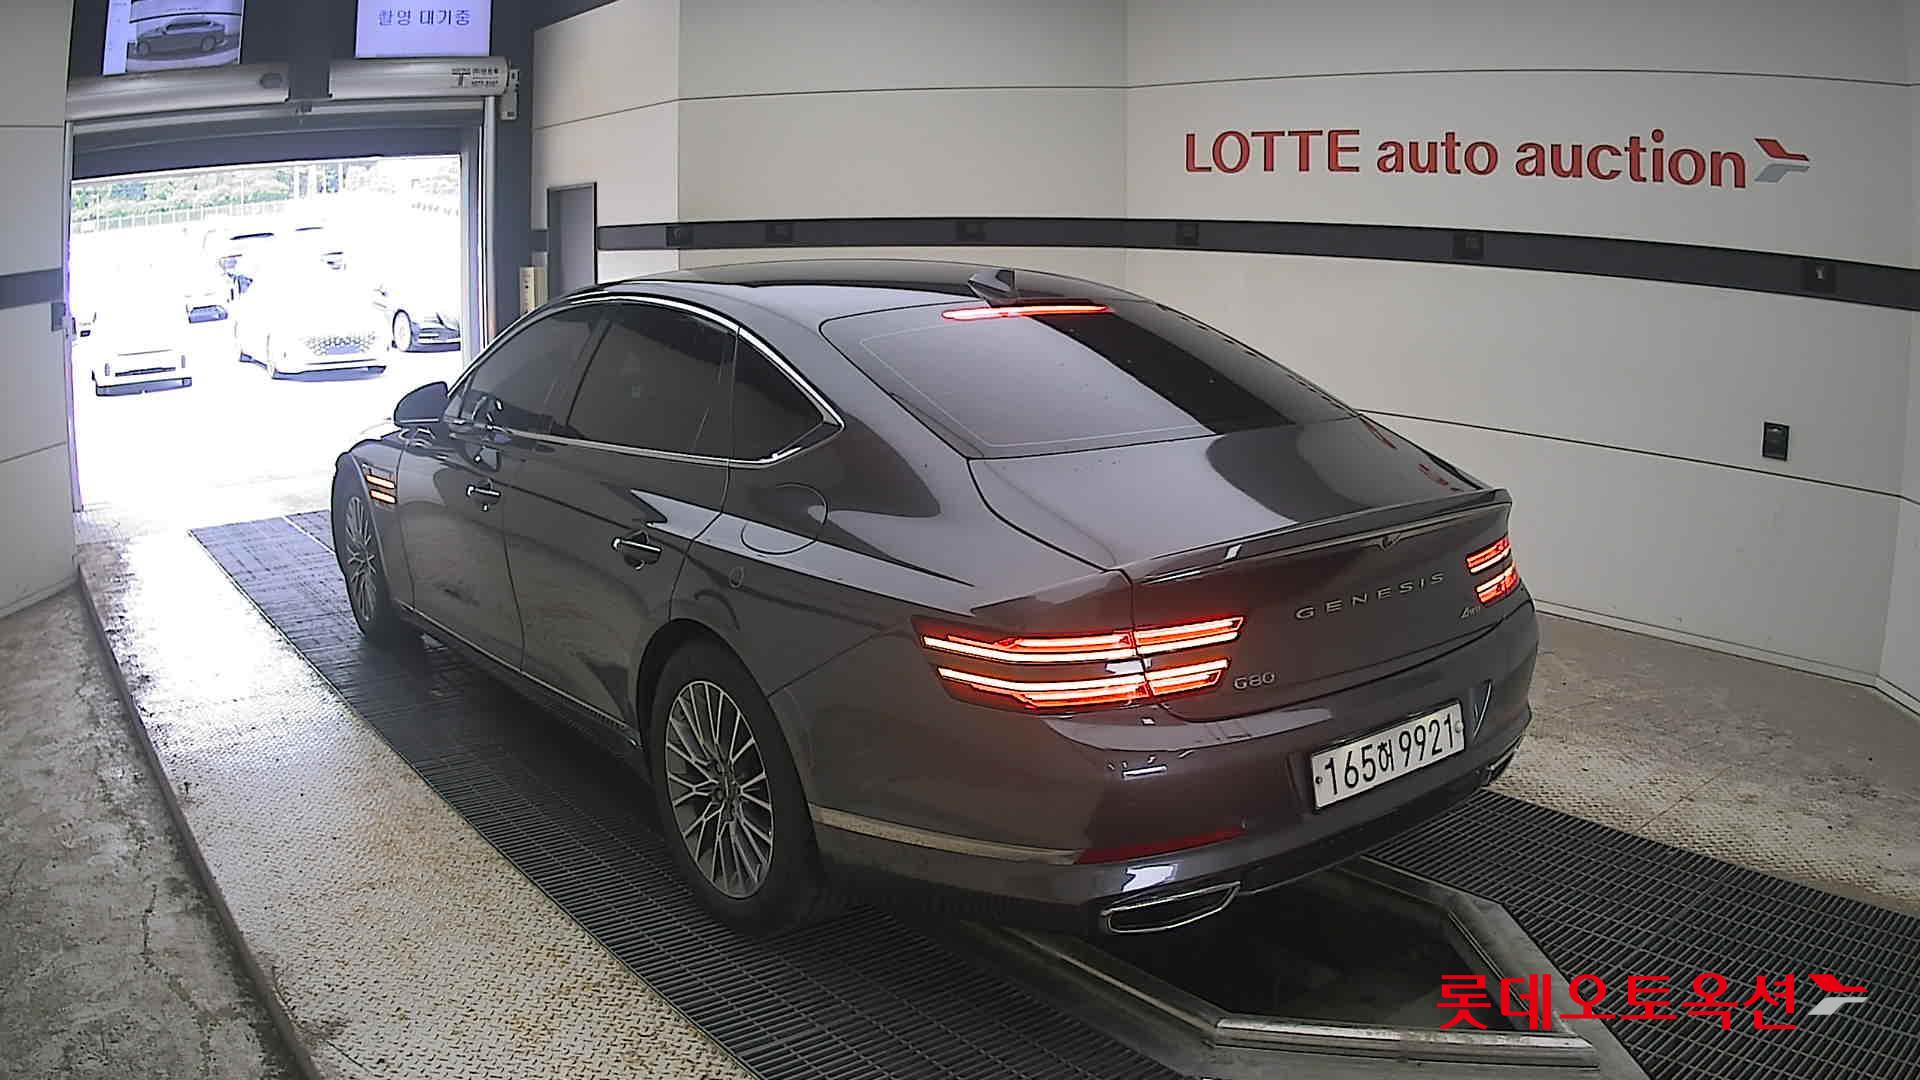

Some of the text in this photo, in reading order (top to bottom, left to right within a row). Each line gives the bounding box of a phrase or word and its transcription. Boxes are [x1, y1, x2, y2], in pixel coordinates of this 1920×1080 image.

[420, 9, 470, 26] 대기중
[1185, 128, 1747, 189] LOTTE auto auction
[1295, 571, 1445, 621] GENESIS
[1233, 671, 1276, 691] G80
